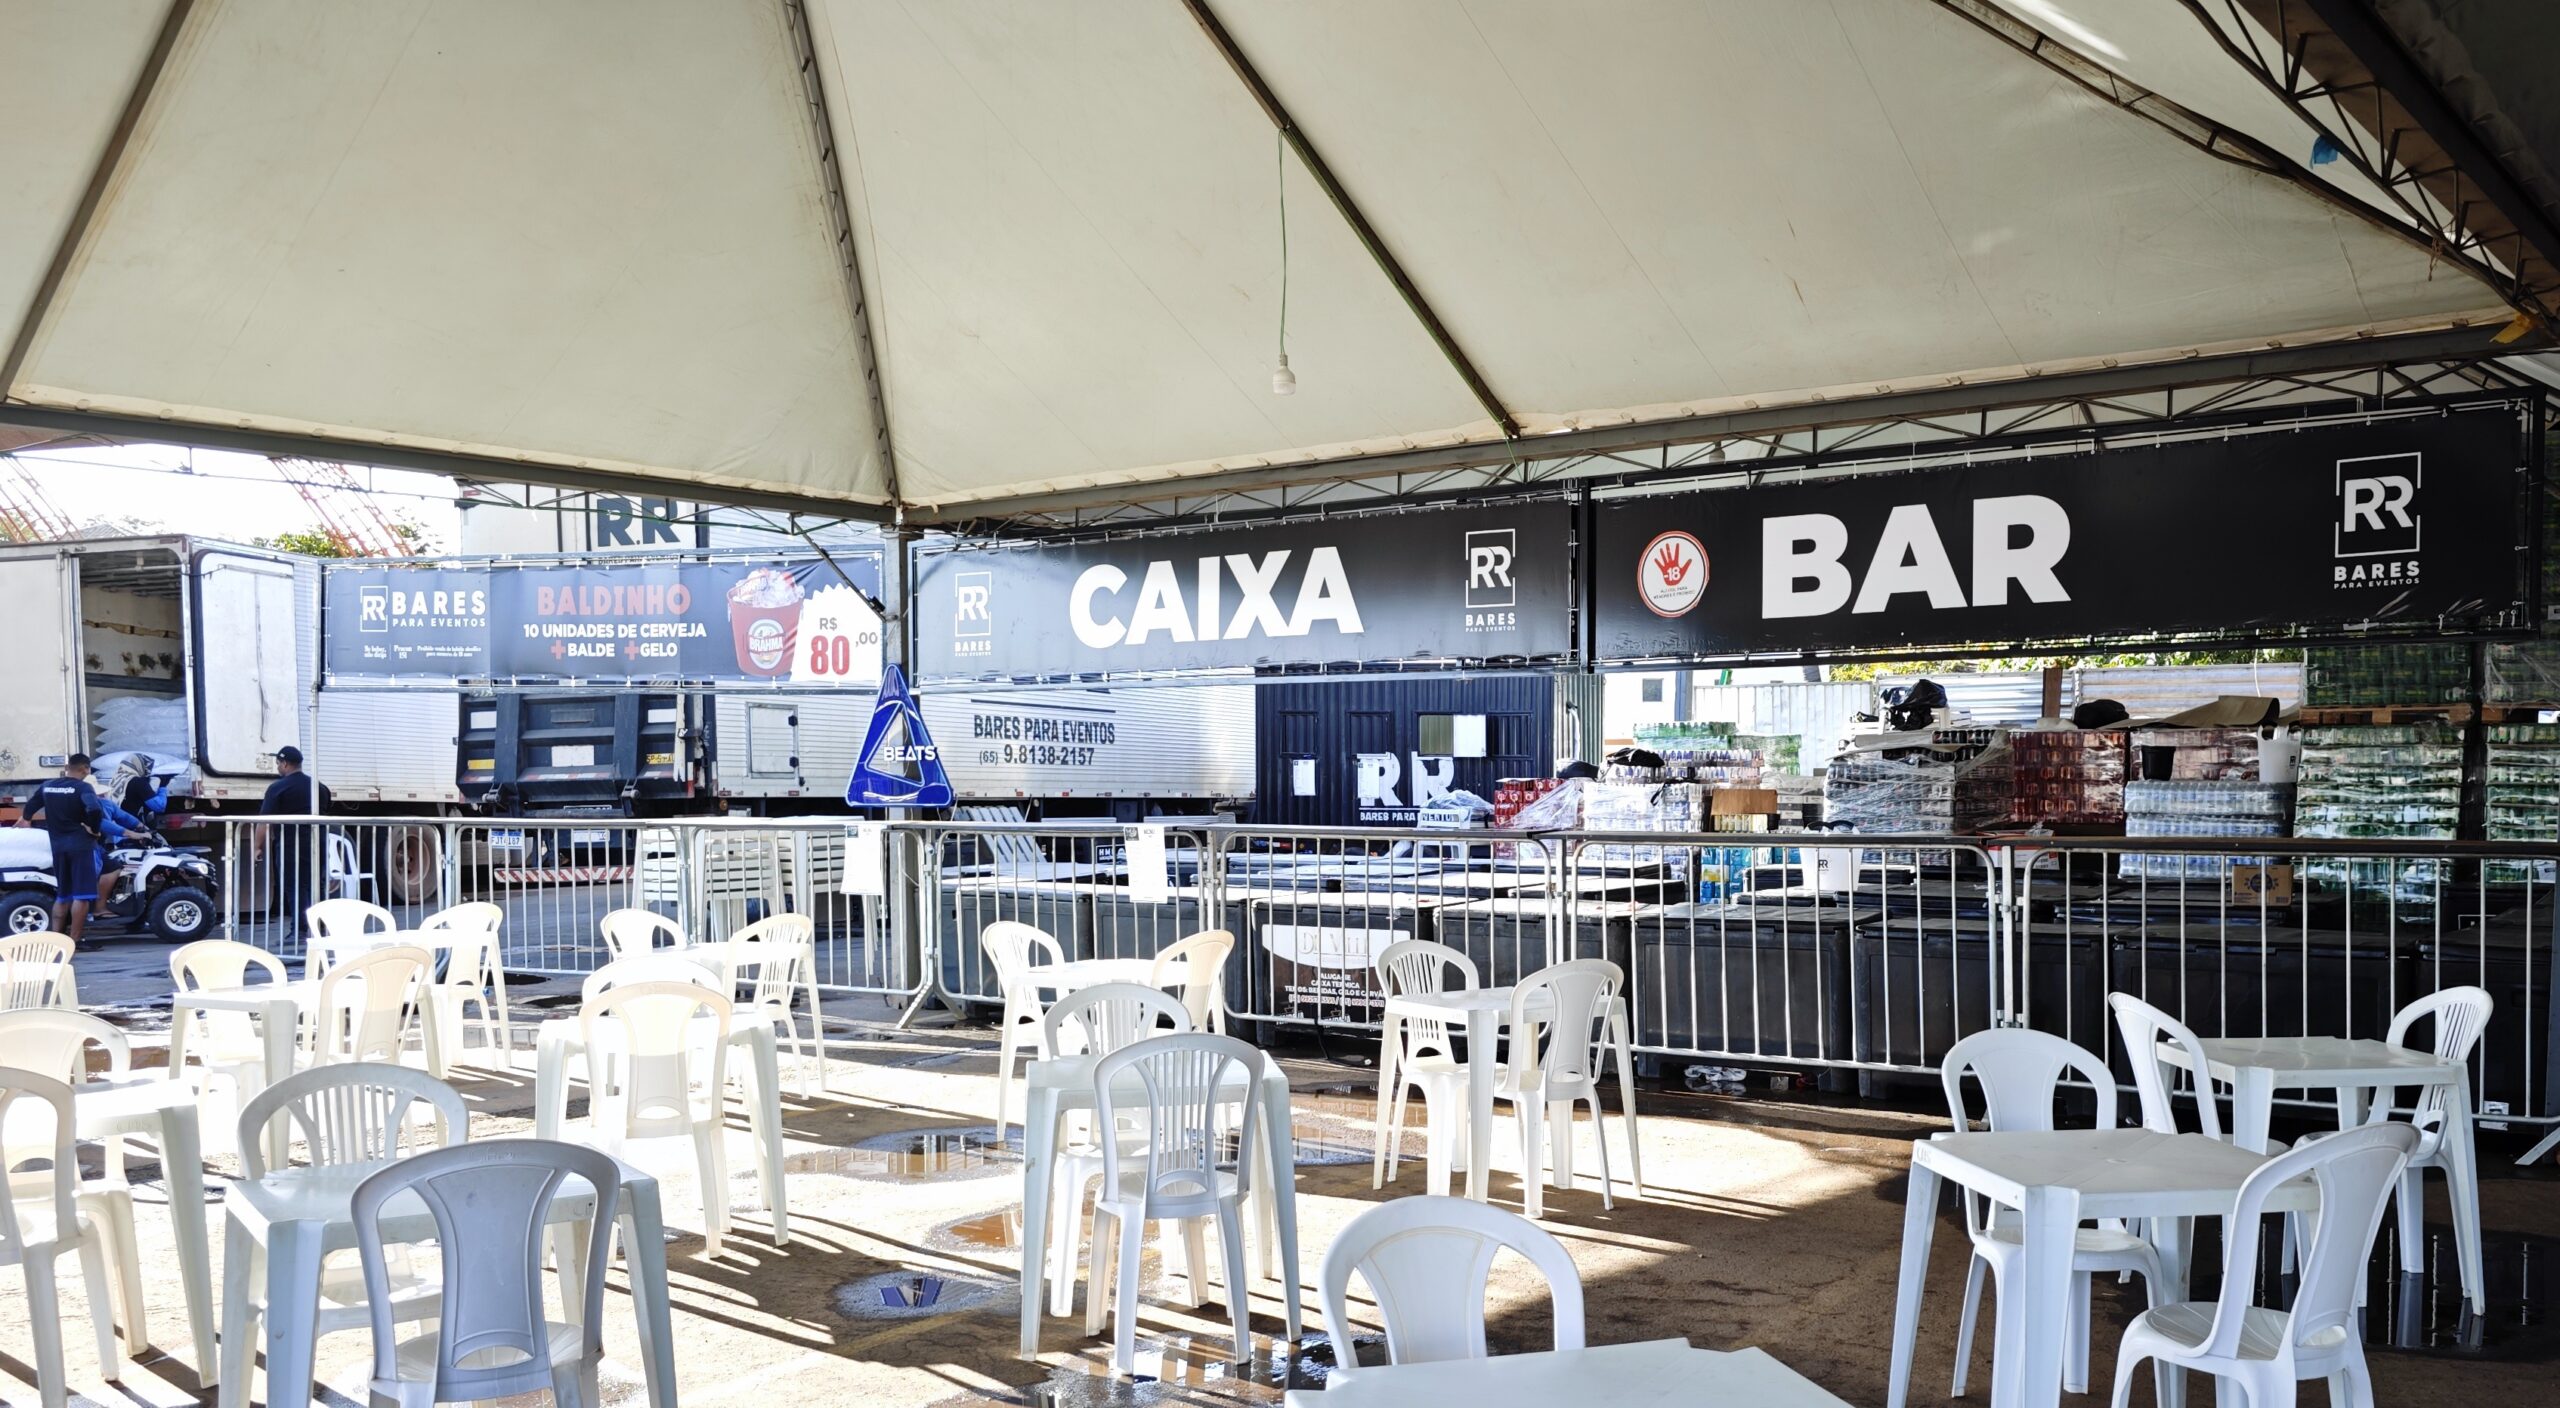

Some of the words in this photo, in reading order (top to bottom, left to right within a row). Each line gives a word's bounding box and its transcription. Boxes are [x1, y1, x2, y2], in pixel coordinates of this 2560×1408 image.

[1762, 495, 2072, 619] BAR
[1664, 567, 1680, 581] -18
[2334, 561, 2420, 581] BARES
[2369, 578, 2419, 587] EVENTOS
[392, 591, 485, 615] BARES
[538, 584, 690, 615] BALDINHO
[1069, 545, 1365, 649] CAIXA
[393, 618, 424, 627] PARA
[431, 618, 485, 627] EVENTOS
[820, 618, 837, 630] R$
[1466, 612, 1515, 626] BARES
[524, 624, 538, 638] 10
[542, 624, 614, 638] UNIDADES
[618, 625, 637, 638] DE
[640, 623, 706, 638] CERVEJA
[750, 636, 783, 651] BRAHMA
[955, 641, 991, 652] BARES
[811, 635, 850, 675] 80
[974, 715, 1020, 739] BARES
[1024, 718, 1059, 742] PARA
[1063, 720, 1115, 744] EVENTOS
[883, 746, 936, 761] BEATS
[980, 750, 998, 766] (65)
[1004, 744, 1094, 765] 9.8138-2157
[1392, 812, 1416, 821] PARA
